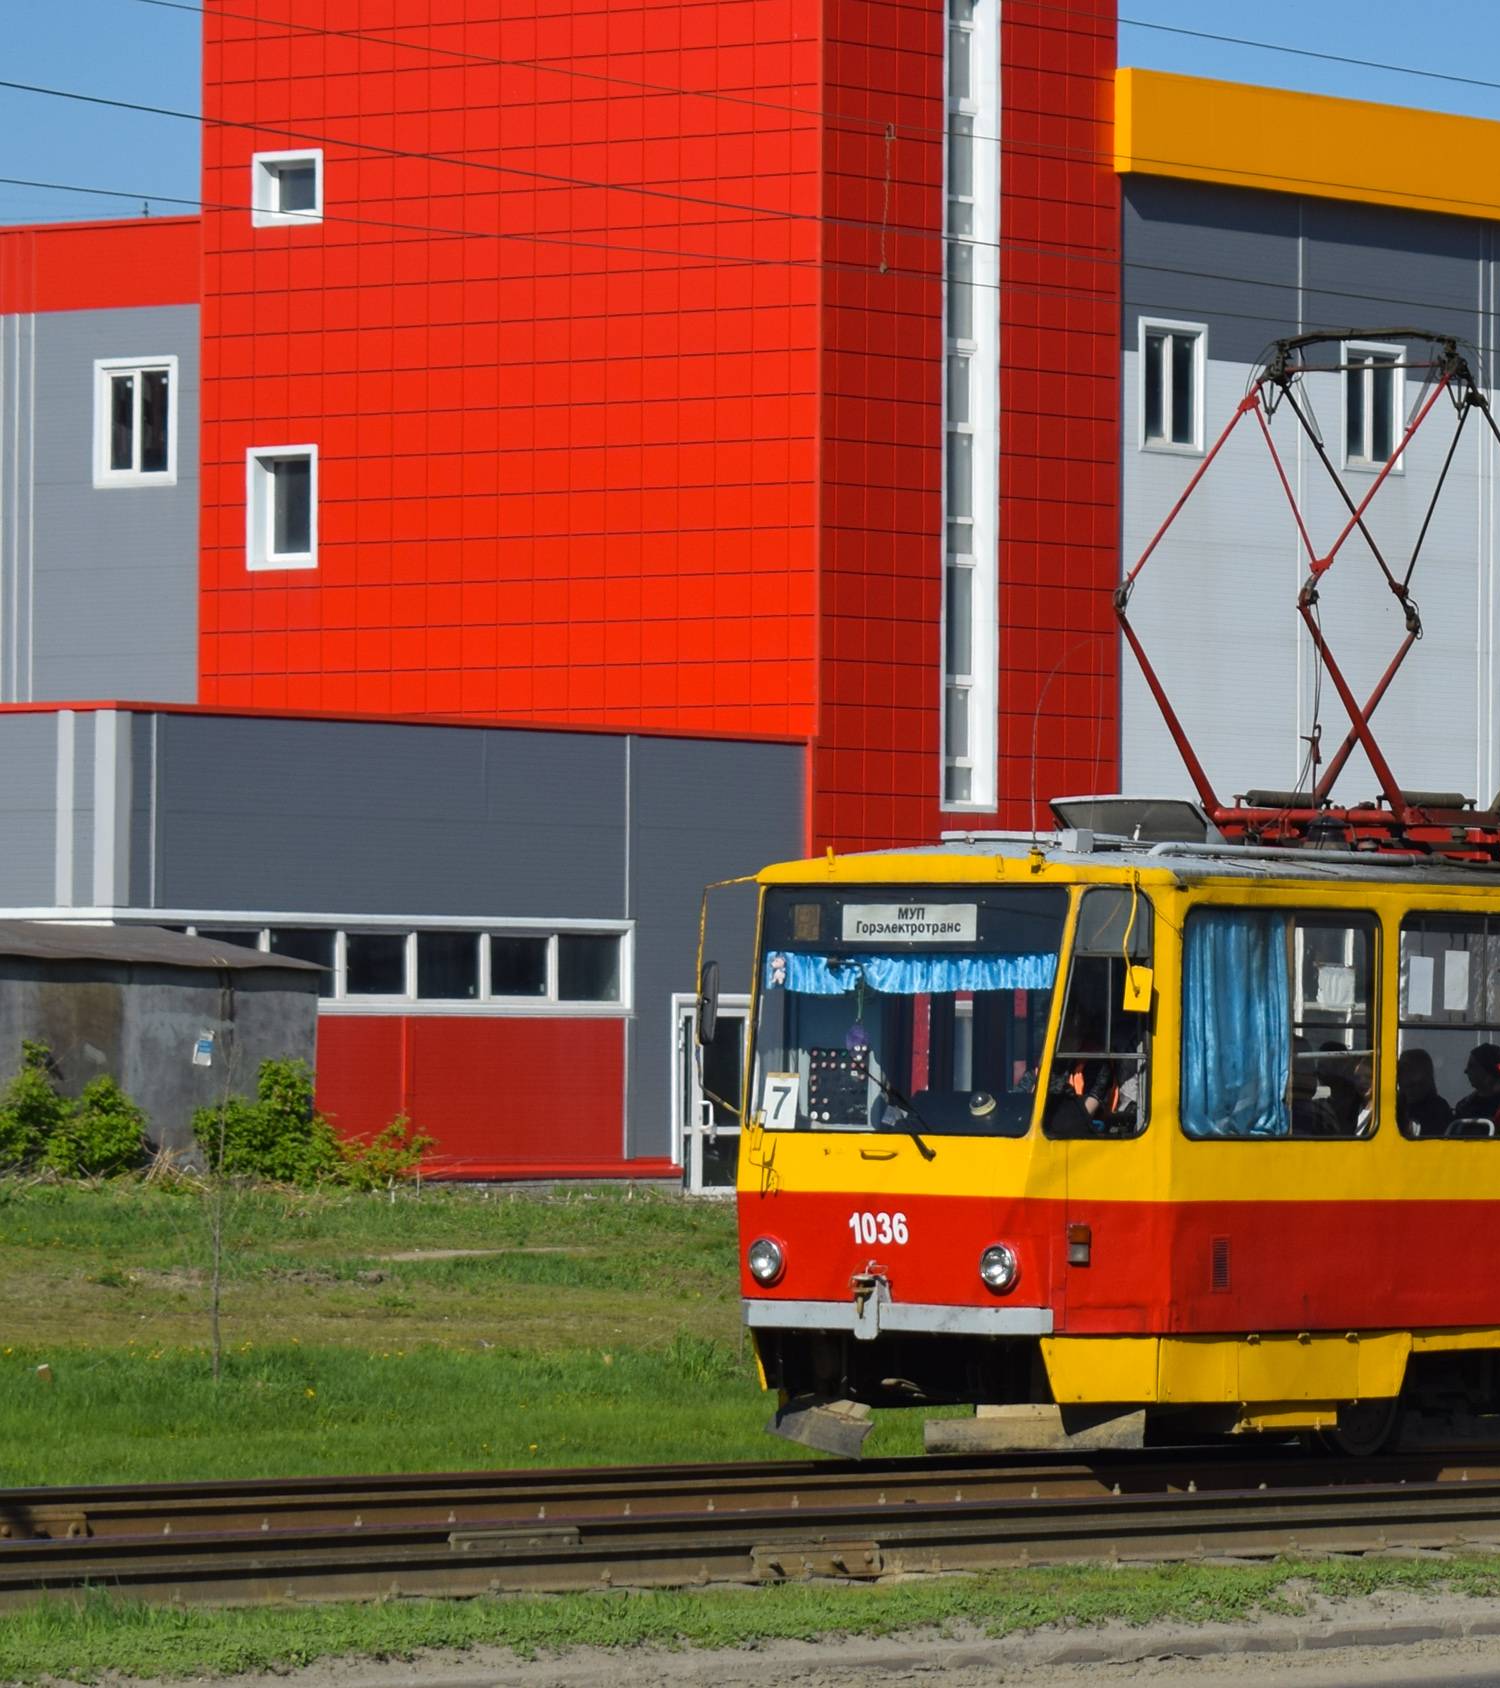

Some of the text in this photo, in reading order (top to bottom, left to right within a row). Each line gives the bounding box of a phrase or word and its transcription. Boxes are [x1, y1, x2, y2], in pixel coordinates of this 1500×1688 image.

[898, 907, 925, 920] МУП
[856, 921, 962, 936] Горэлектротранс
[772, 1086, 792, 1120] 7
[848, 1211, 909, 1245] 1036
